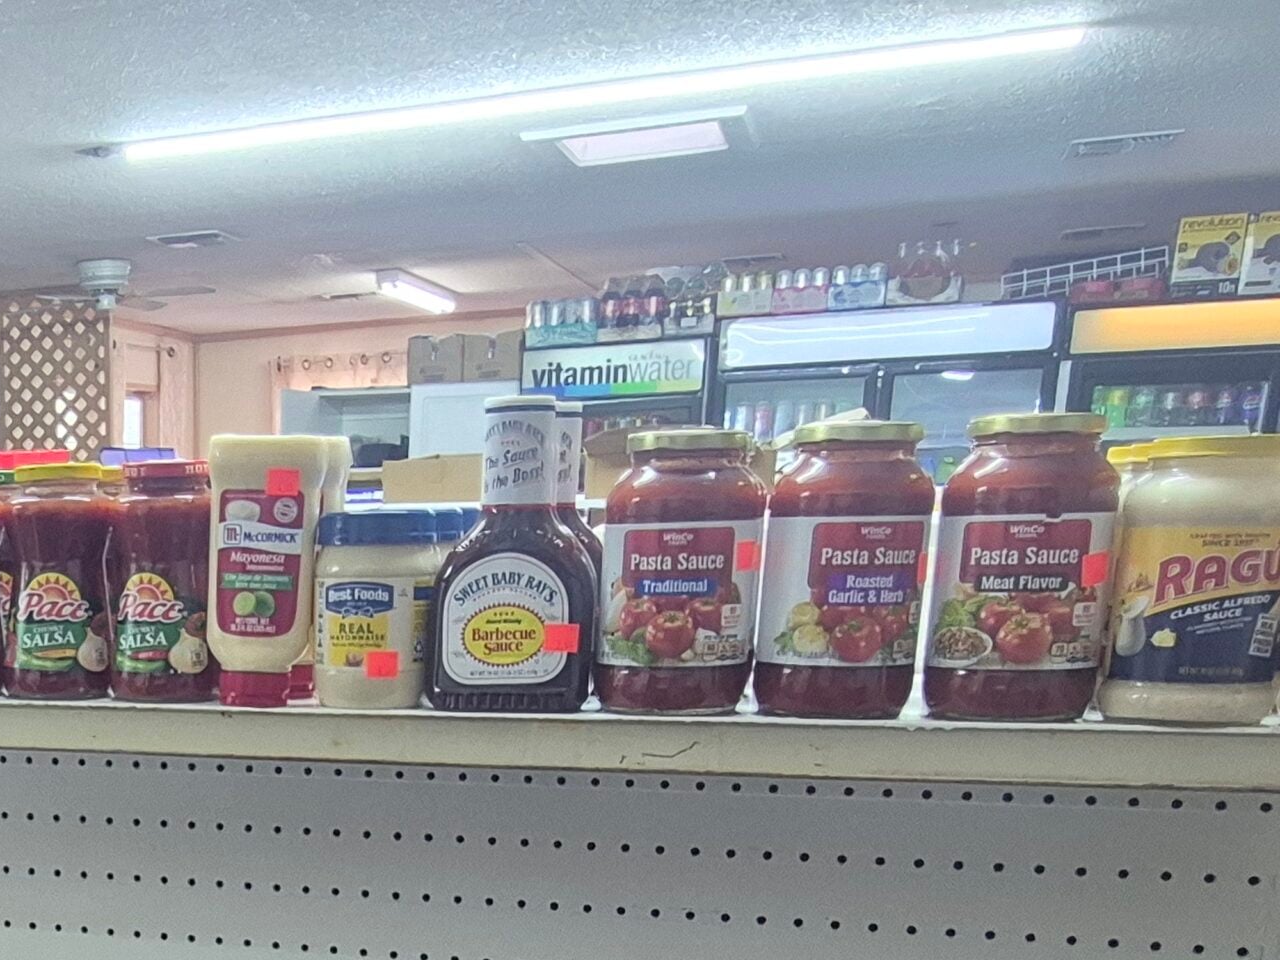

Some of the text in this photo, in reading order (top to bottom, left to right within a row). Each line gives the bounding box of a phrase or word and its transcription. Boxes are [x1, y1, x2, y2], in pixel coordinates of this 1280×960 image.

[230, 551, 286, 565] Mayonesa
[630, 552, 725, 571] Pasta Sauce
[821, 547, 916, 566] Pasta Sauce
[970, 547, 1079, 566] Pasta Sauce
[453, 573, 488, 607] SWEET
[491, 571, 525, 587] BABY
[524, 574, 558, 603] RAY'S
[642, 579, 708, 593] Traditional
[845, 575, 894, 589] Roasted
[980, 575, 1063, 591] Meat Flavor
[328, 587, 389, 603] Best Foods
[828, 588, 903, 604] Garlic & Herb
[19, 590, 90, 624] Pace
[119, 590, 183, 624] Pace
[1169, 594, 1272, 620] CLASSIC ALFREDO
[1203, 607, 1244, 623] SAUCE
[338, 622, 375, 634] REAL
[472, 627, 537, 642] Barbecue
[22, 631, 76, 648] SALSA
[120, 631, 168, 647] SALSA
[483, 640, 524, 656] Sauce
